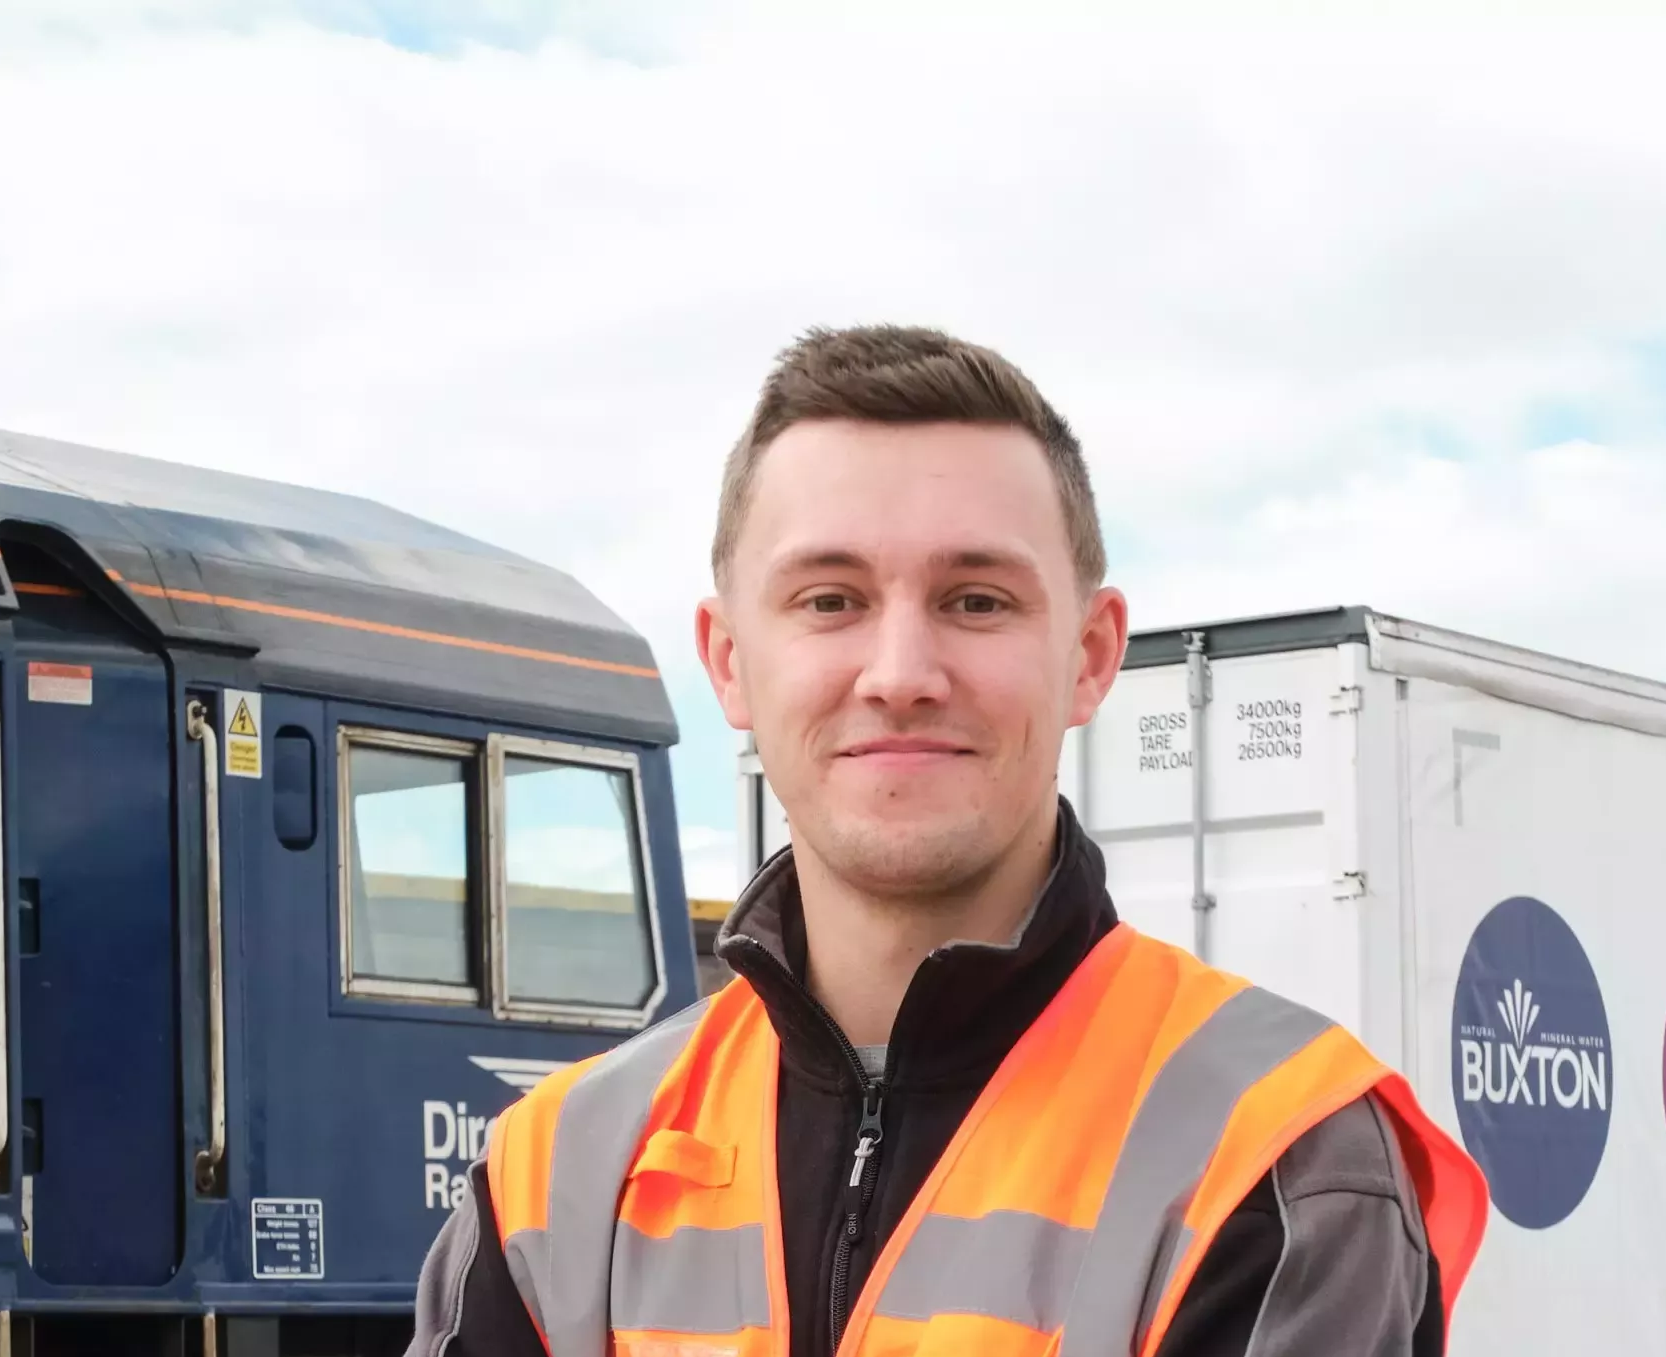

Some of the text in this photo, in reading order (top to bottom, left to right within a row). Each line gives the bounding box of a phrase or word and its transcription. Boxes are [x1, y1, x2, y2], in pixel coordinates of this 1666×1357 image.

[1139, 699, 1302, 733] GROSS 34000kg
[1140, 720, 1302, 753] TARE 7500kg
[1238, 740, 1302, 761] 26500kg
[1460, 1025, 1496, 1039] NATURAL
[1540, 1032, 1604, 1048] MINERAL WATER
[1460, 1039, 1607, 1111] BUXTON
